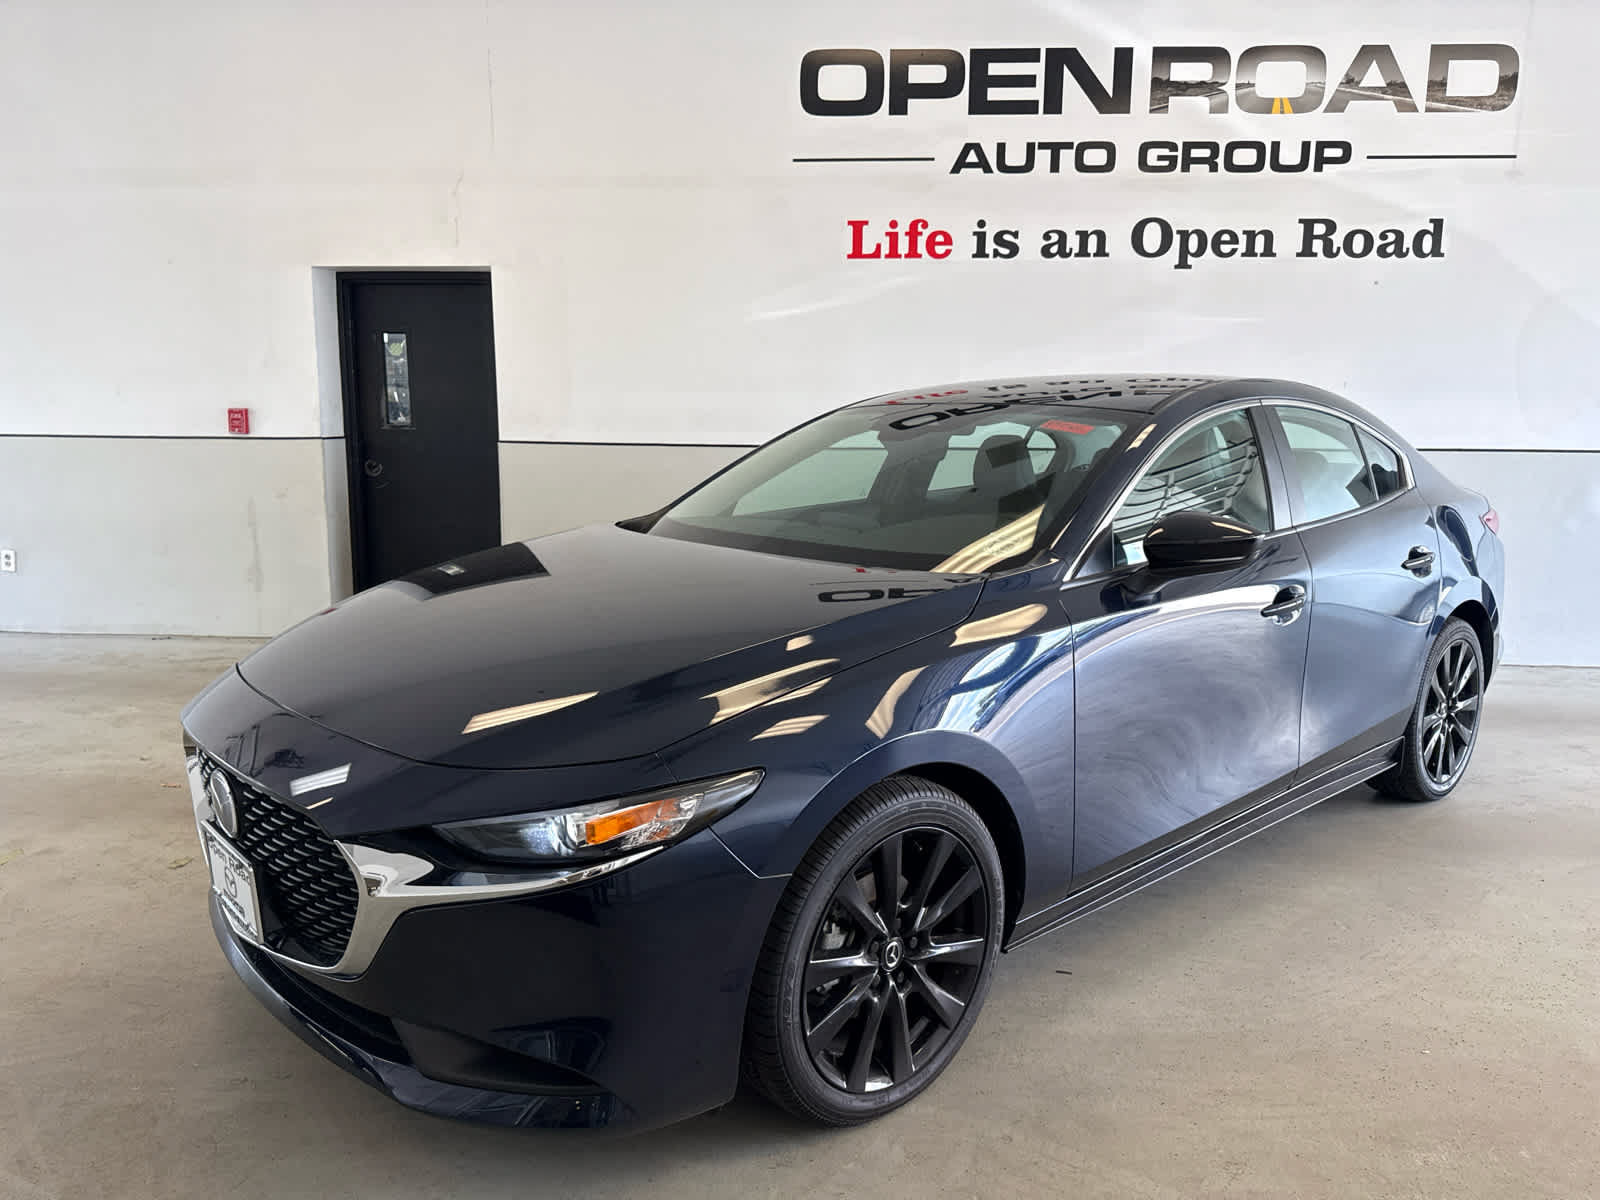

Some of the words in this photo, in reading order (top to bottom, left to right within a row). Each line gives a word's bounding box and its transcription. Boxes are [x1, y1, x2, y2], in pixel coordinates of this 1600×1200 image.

[800, 47, 1134, 116] OPEN
[1149, 44, 1520, 114] ROAD
[950, 141, 1117, 175] AUTO
[1138, 140, 1353, 174] GROUP
[847, 218, 953, 260] Life
[972, 219, 1020, 259] is
[1041, 229, 1110, 259] an
[1131, 217, 1277, 270] Open
[1296, 218, 1445, 259] Road
